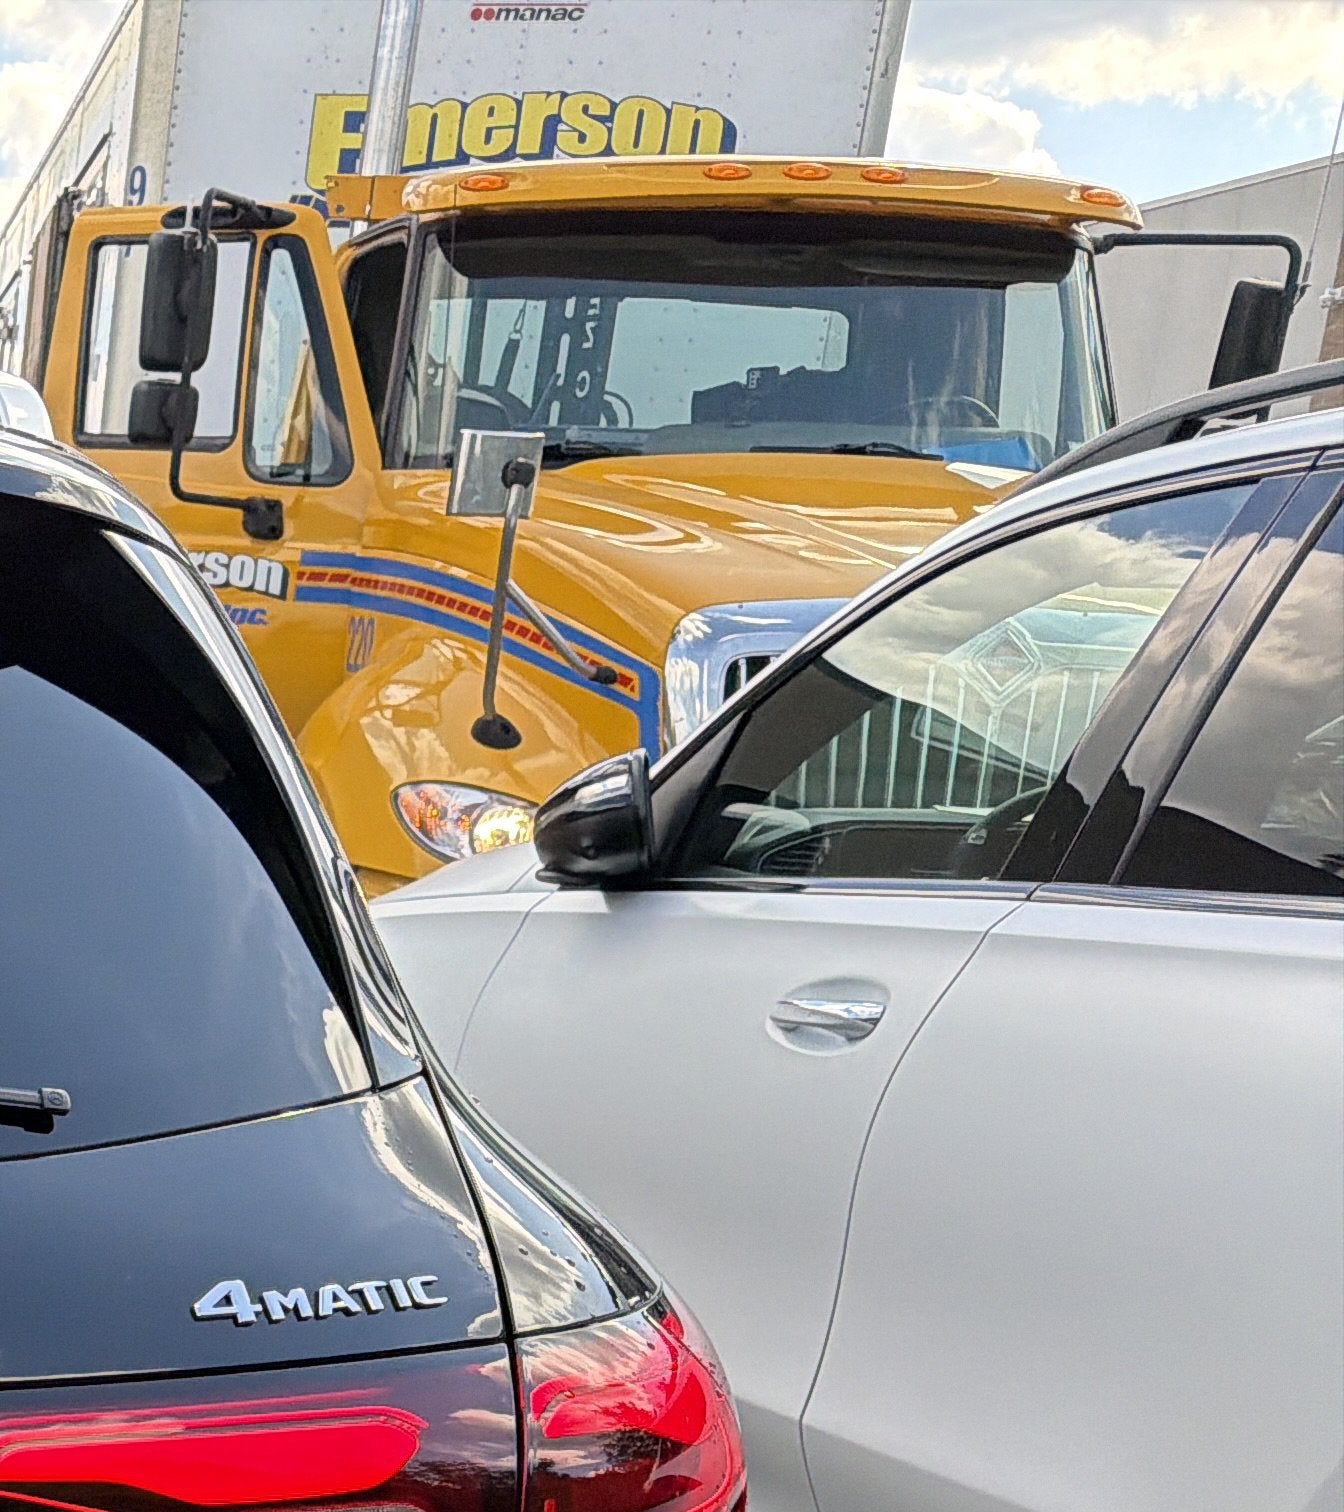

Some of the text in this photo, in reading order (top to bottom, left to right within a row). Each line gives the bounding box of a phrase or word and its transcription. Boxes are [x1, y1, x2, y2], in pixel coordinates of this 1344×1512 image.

[495, 7, 585, 21] manac
[306, 91, 737, 190] Emerson
[192, 1275, 449, 1327] 4MATIC
